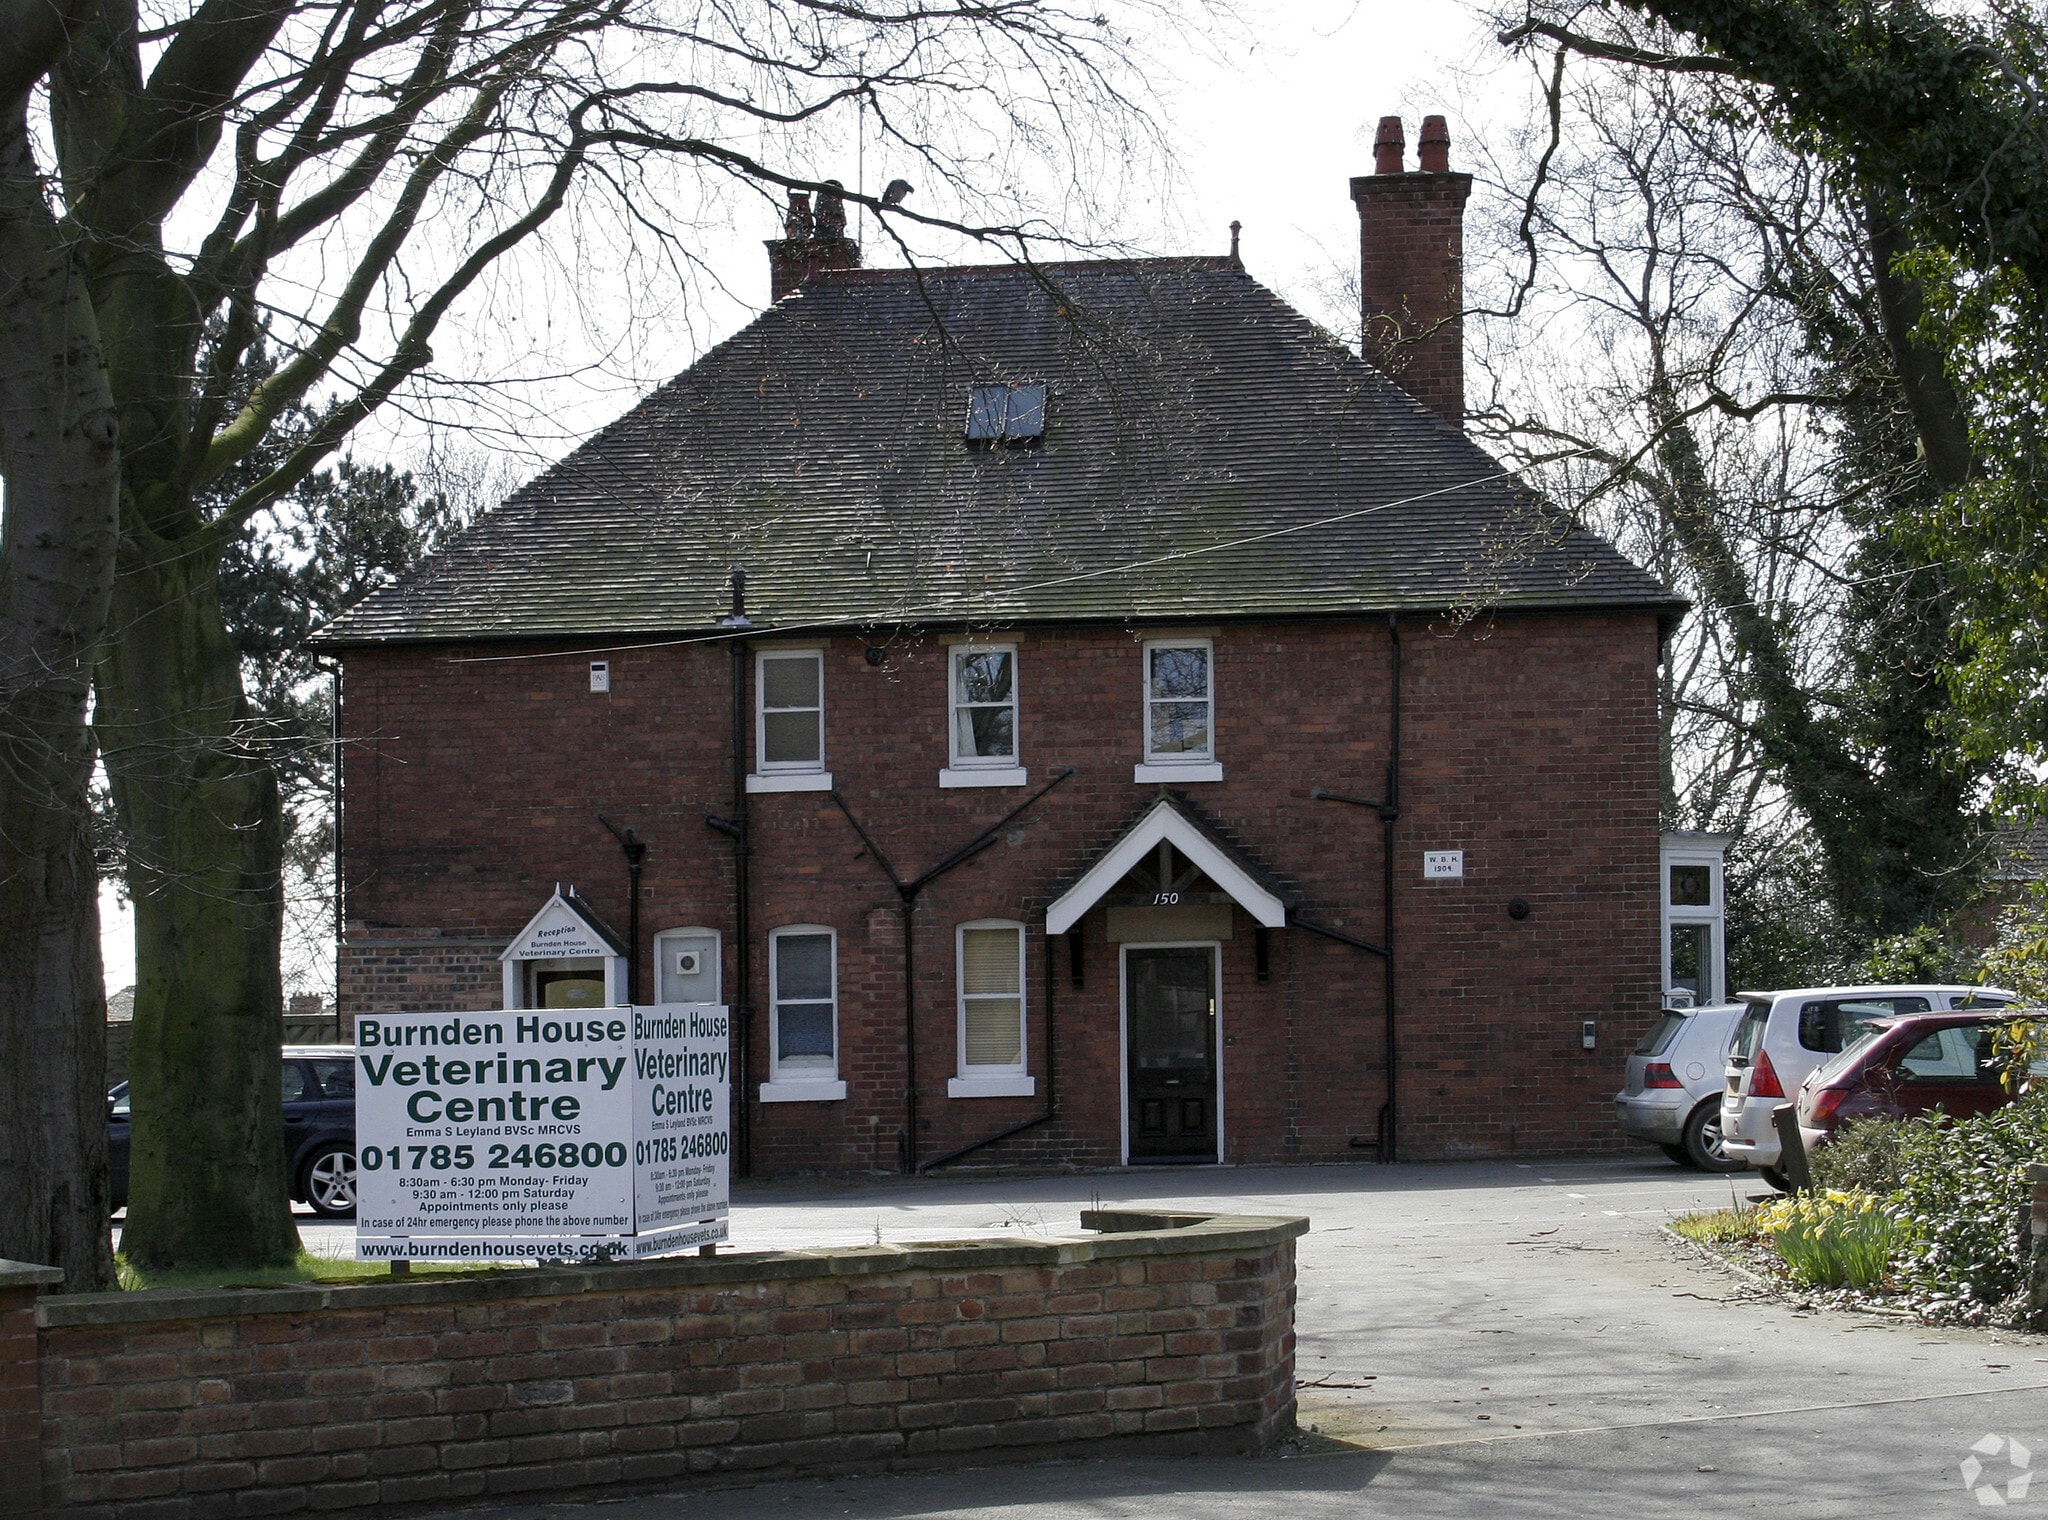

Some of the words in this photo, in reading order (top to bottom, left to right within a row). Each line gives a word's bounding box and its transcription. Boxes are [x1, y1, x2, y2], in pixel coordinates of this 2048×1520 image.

[1153, 893, 1179, 905] 150
[538, 926, 576, 938] Reception
[359, 1018, 503, 1047] Burnden
[516, 1016, 626, 1043] House
[634, 1012, 686, 1040] Burnden
[690, 1012, 727, 1038] House
[359, 1052, 626, 1090] Veterinary
[634, 1046, 727, 1083] Veterinary
[407, 1090, 580, 1123] Centre
[652, 1083, 713, 1117] Centre
[406, 1127, 441, 1137] Emma
[445, 1127, 452, 1136] S
[456, 1126, 500, 1138] Leyland
[505, 1125, 534, 1135] BVSc
[538, 1125, 581, 1135] MRCVS
[361, 1145, 474, 1171] 01785
[488, 1142, 627, 1168] 246800
[636, 1137, 677, 1166] 01785
[681, 1131, 728, 1159] 246800
[399, 1178, 440, 1187] 8:30am
[451, 1177, 474, 1187] 6:30
[478, 1179, 496, 1188] pm
[553, 1175, 588, 1187] Friday
[412, 1190, 436, 1199] 9:30
[440, 1191, 456, 1199] am
[468, 1189, 498, 1199] 12:00
[502, 1190, 520, 1200] pm
[523, 1188, 575, 1200] Saturday
[419, 1202, 499, 1214] Appointments
[503, 1201, 527, 1212] only
[530, 1201, 568, 1212] please
[361, 1218, 369, 1228] In
[372, 1219, 393, 1228] case
[395, 1217, 405, 1227] of
[407, 1217, 427, 1227] 24hr
[430, 1218, 480, 1229] emergency
[482, 1216, 512, 1228] please
[515, 1216, 543, 1228] phone
[546, 1216, 560, 1226] the
[563, 1215, 590, 1226] above
[593, 1215, 629, 1225] number
[361, 1241, 628, 1256] www.burndenhousevets.couk
[636, 1223, 728, 1254] www.burndenhousevets.co.uk
